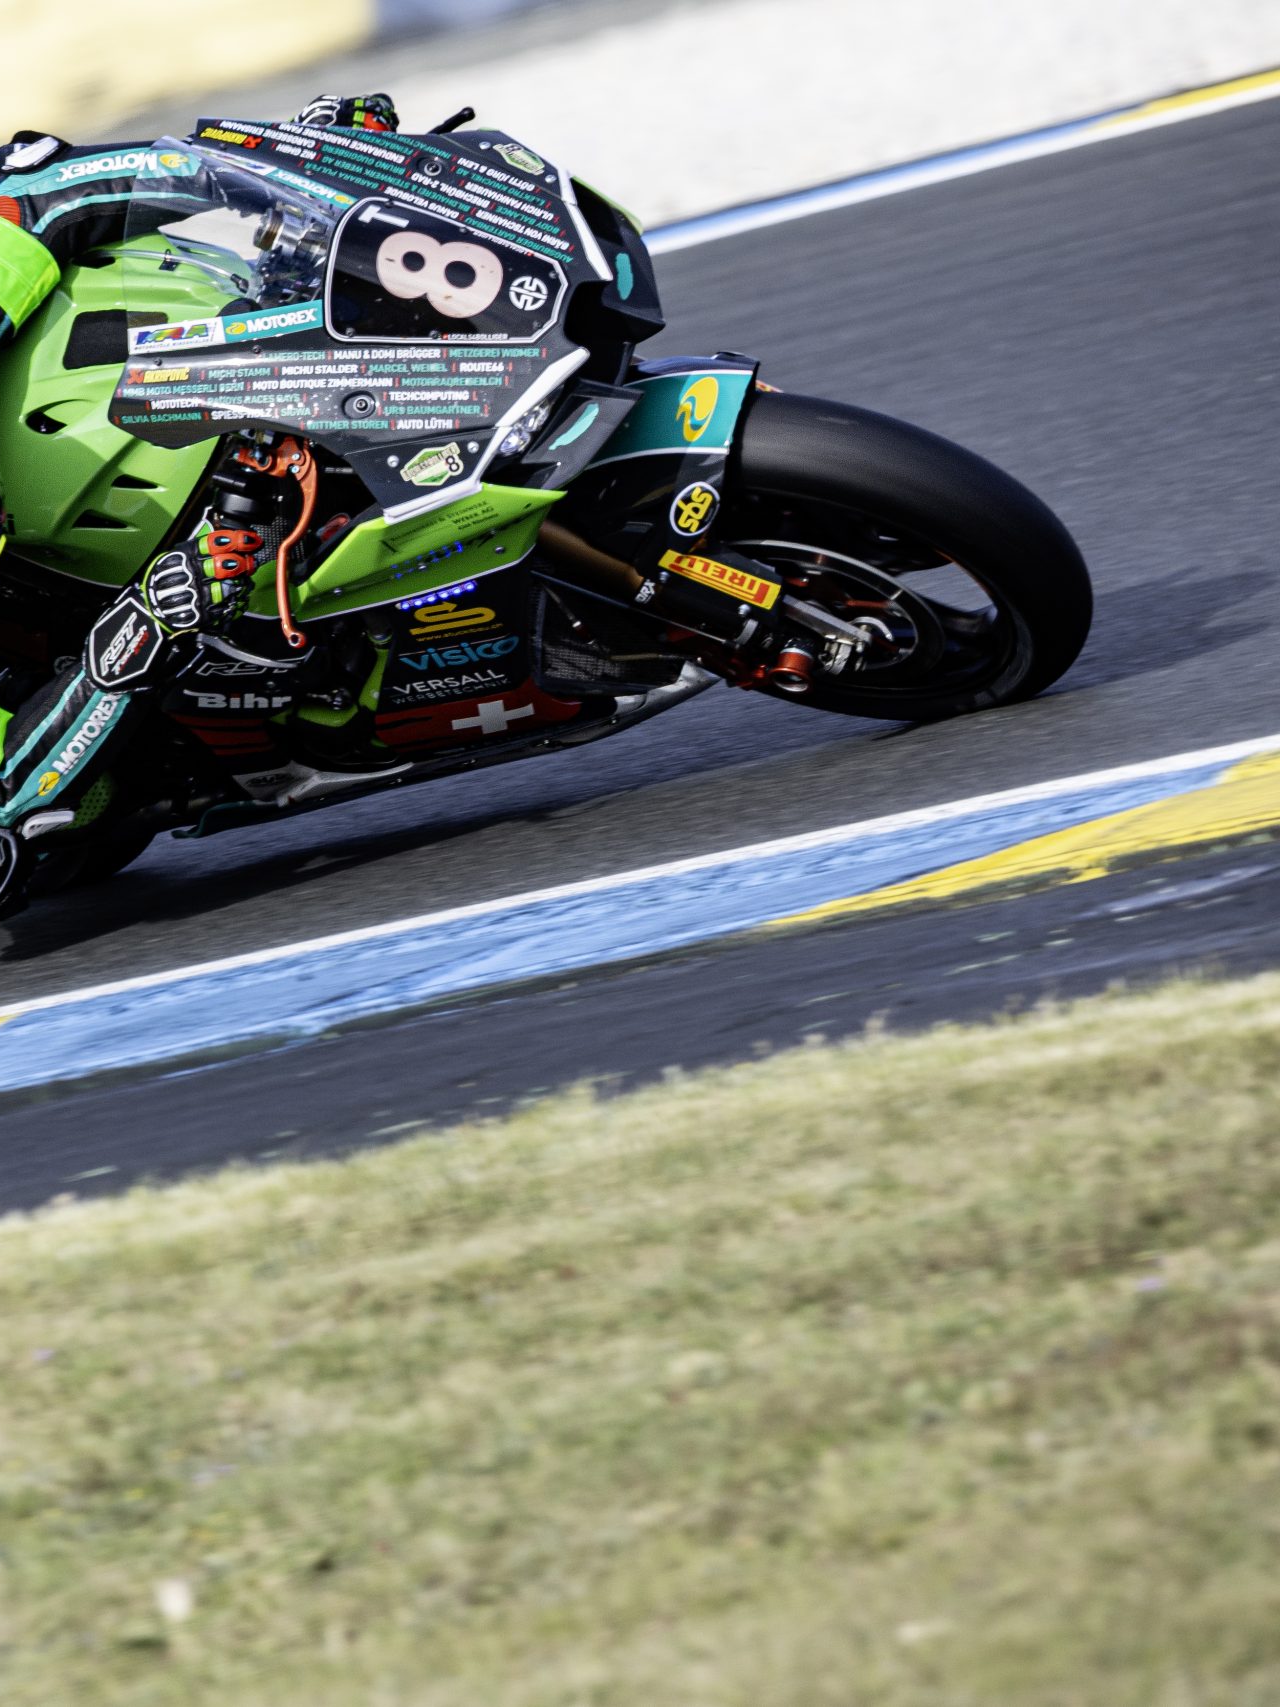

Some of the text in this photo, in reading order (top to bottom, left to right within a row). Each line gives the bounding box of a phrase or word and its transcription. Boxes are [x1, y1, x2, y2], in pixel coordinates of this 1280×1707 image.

[301, 128, 350, 147] HARDCORE
[349, 141, 405, 162] ENDURANCE
[58, 152, 158, 183] MOTOREX
[273, 170, 336, 199] MOTOREX
[358, 205, 410, 228] T
[376, 231, 504, 318] 8
[246, 309, 318, 333] MOTOREX
[333, 350, 362, 360] MANU
[363, 350, 370, 359] &
[314, 364, 358, 374] STALDER
[459, 362, 505, 372] ROUTE66
[252, 381, 278, 391] MOTO
[327, 378, 393, 388] ZIMMERMANN
[389, 391, 470, 401] TECHCOMPUTING
[122, 412, 202, 424] SILVIA BACHMANN
[406, 405, 481, 415] BAUMGARTNER
[424, 417, 453, 429] LÜTHI
[445, 455, 460, 473] 8
[669, 555, 771, 604] PIRELLI
[99, 611, 138, 677] RST
[400, 635, 519, 670] visico
[392, 669, 505, 695] VERSALL
[183, 689, 292, 709] Bihr
[52, 691, 123, 775] MOTOREX
